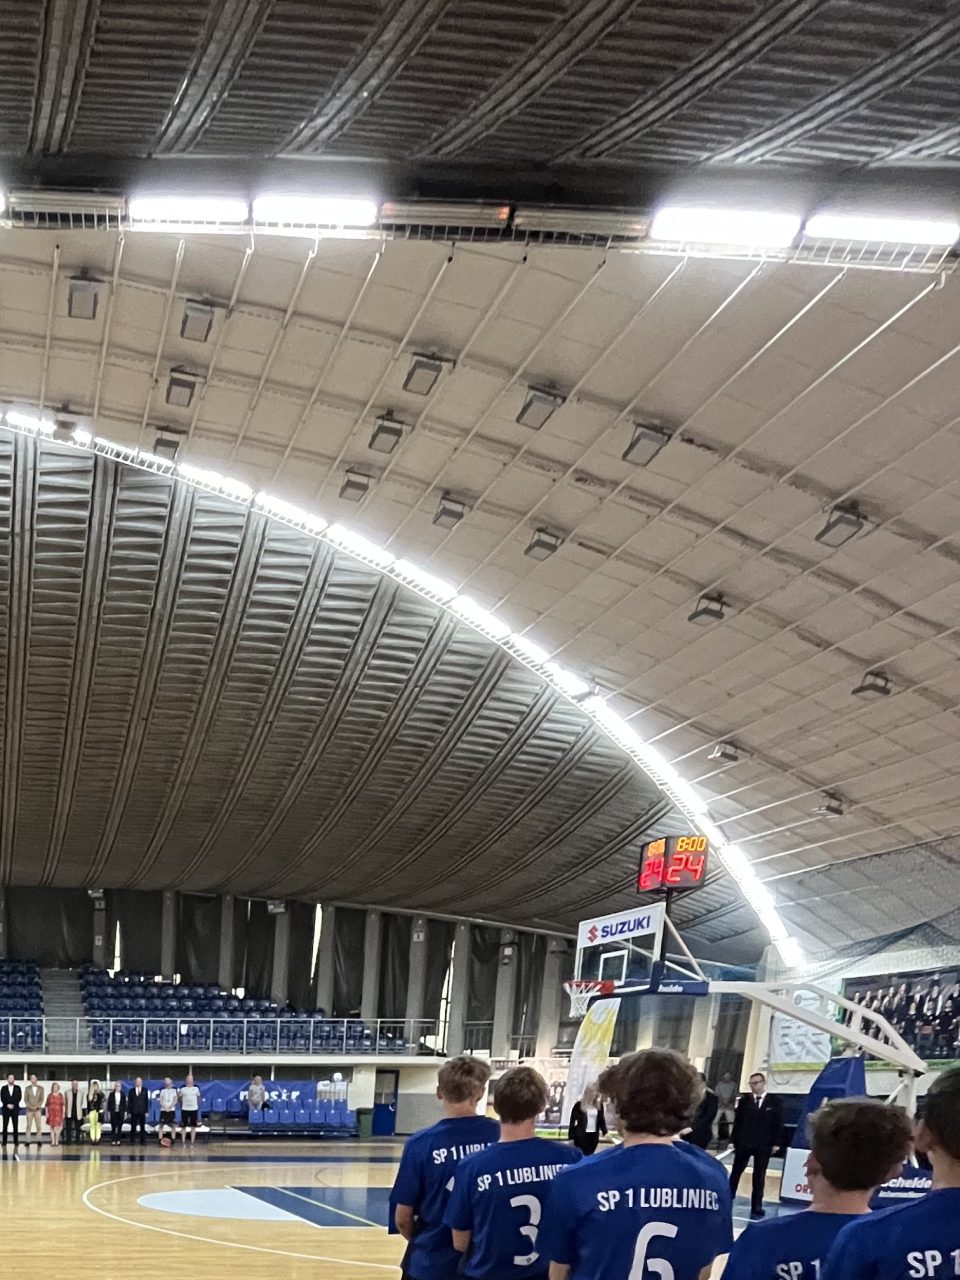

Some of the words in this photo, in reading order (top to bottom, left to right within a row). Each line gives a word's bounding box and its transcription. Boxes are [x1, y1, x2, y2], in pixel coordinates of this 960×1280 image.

[676, 836, 707, 851] 8:00
[640, 858, 665, 887] 24
[666, 853, 705, 882] 24
[600, 915, 651, 938] SUZUKI
[432, 1148, 448, 1164] SP
[450, 1145, 457, 1160] 1
[477, 1174, 492, 1192] SP
[495, 1170, 503, 1186] 1
[597, 1190, 620, 1211] SP
[625, 1188, 634, 1208] 1
[640, 1188, 719, 1211] LUBLINIEC
[509, 1194, 542, 1266] 3
[810, 1258, 821, 1280] 1
[906, 1249, 943, 1279] SP
